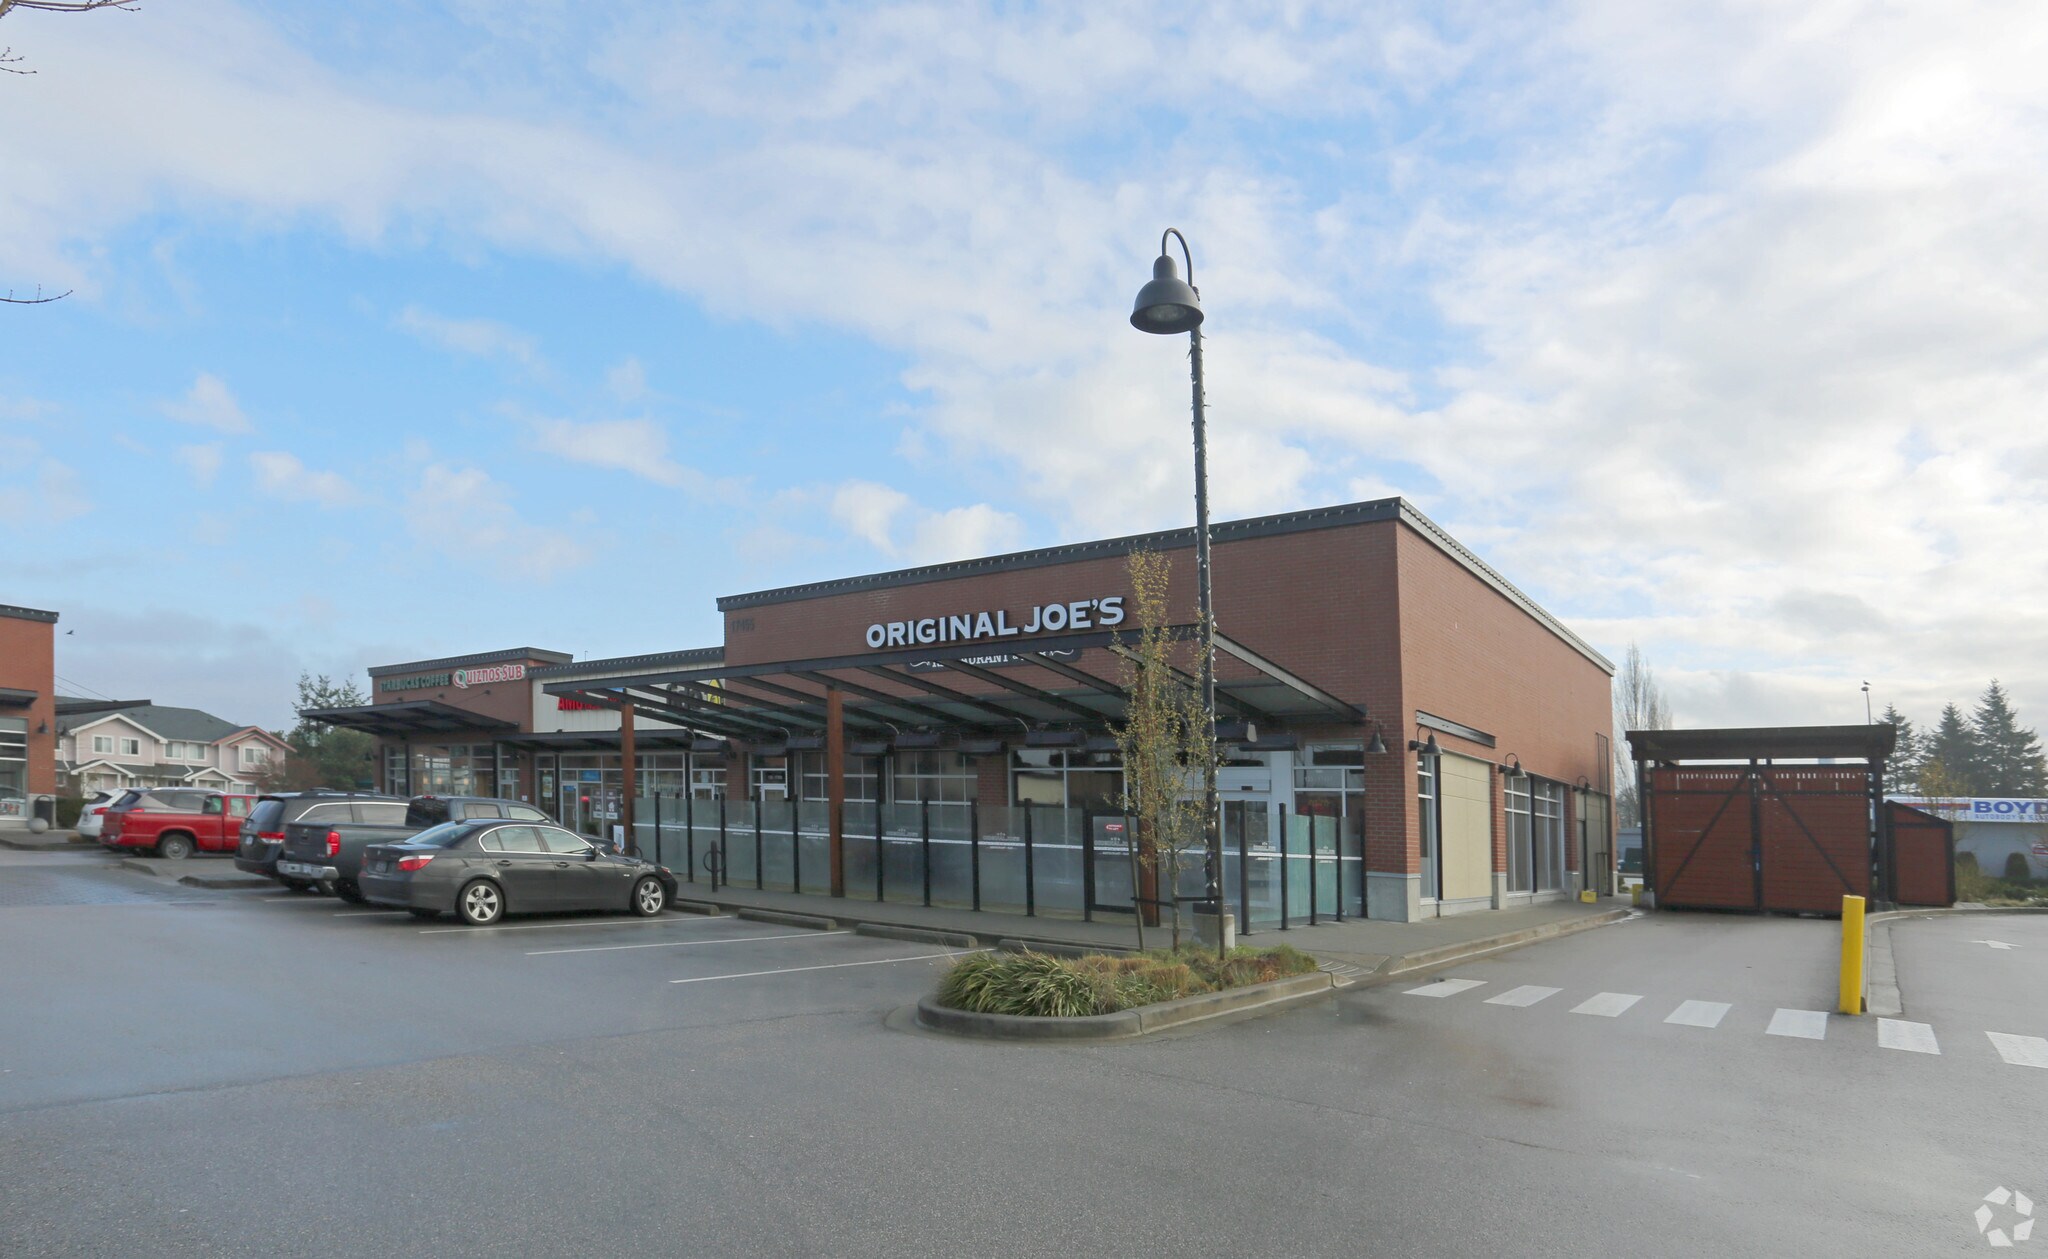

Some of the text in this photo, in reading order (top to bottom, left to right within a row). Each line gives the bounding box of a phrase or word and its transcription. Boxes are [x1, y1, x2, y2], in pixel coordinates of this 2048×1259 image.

[866, 597, 1125, 649] ORIGINAL JOE'S
[421, 673, 450, 688] COFFEE
[453, 667, 501, 688] QUIZNOS
